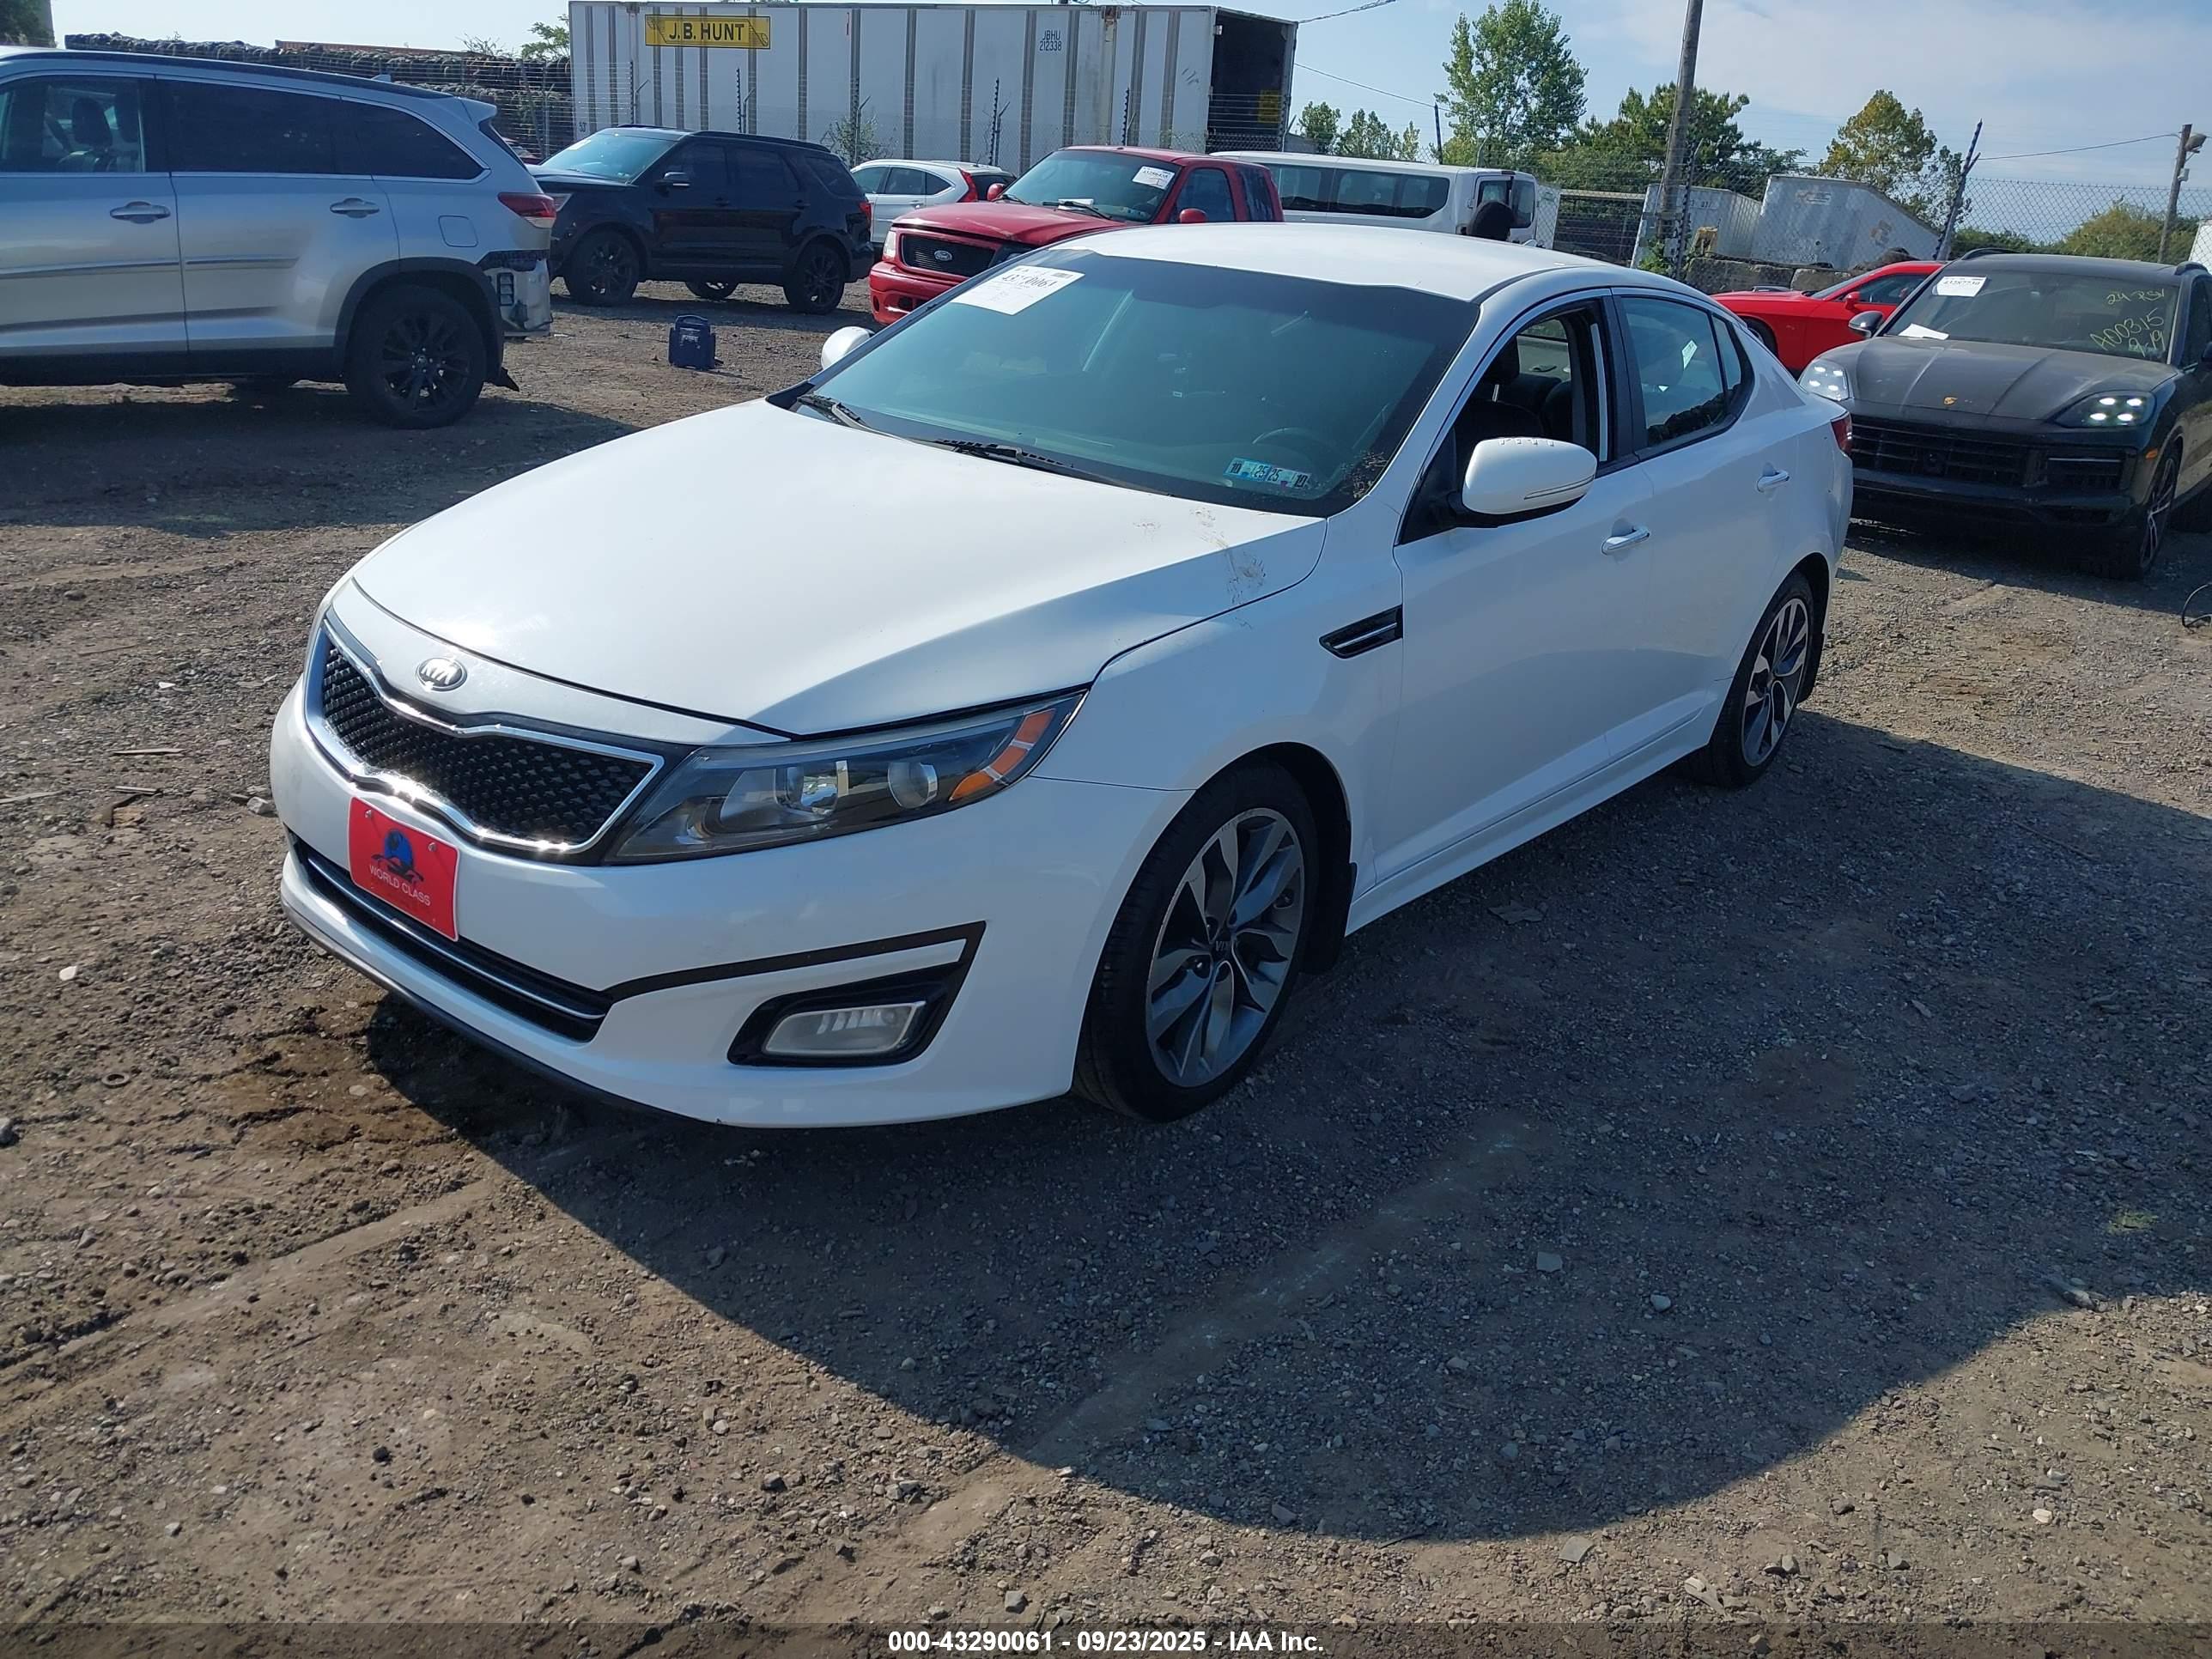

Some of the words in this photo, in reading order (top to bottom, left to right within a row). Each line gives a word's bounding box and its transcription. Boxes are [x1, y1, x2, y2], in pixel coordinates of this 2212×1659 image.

[669, 22, 696, 40] J.B.
[700, 22, 744, 41] HUNT
[1042, 29, 1061, 41] JBHU
[1039, 40, 1062, 52] 212338
[1230, 463, 1243, 474] 10
[1255, 465, 1269, 478] 25
[1268, 469, 1283, 482] 25
[1294, 474, 1309, 488] 10
[369, 864, 399, 889] WORLD
[401, 882, 431, 907] CLASS
